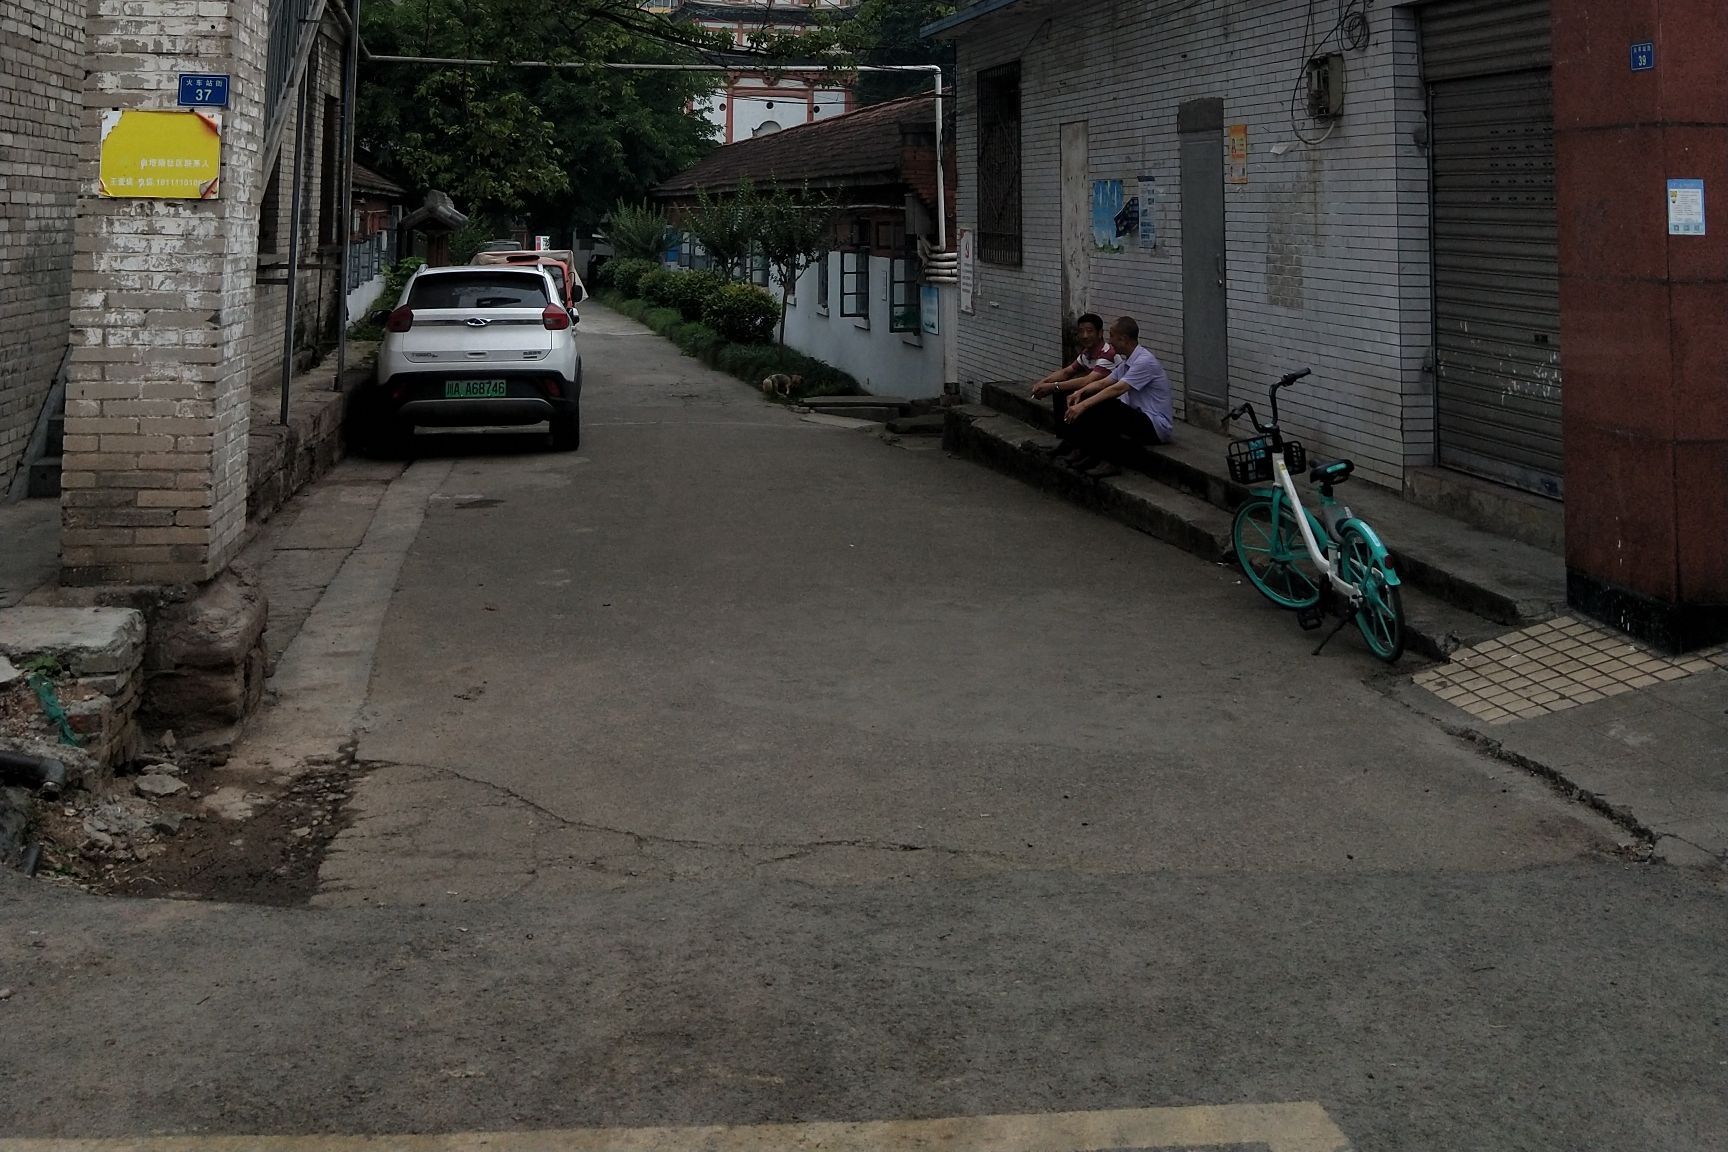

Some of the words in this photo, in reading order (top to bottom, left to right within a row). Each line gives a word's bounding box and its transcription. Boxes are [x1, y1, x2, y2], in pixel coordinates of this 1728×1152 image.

[1638, 54, 1647, 66] 39
[185, 79, 223, 87] 火车站街
[195, 89, 212, 101] 37
